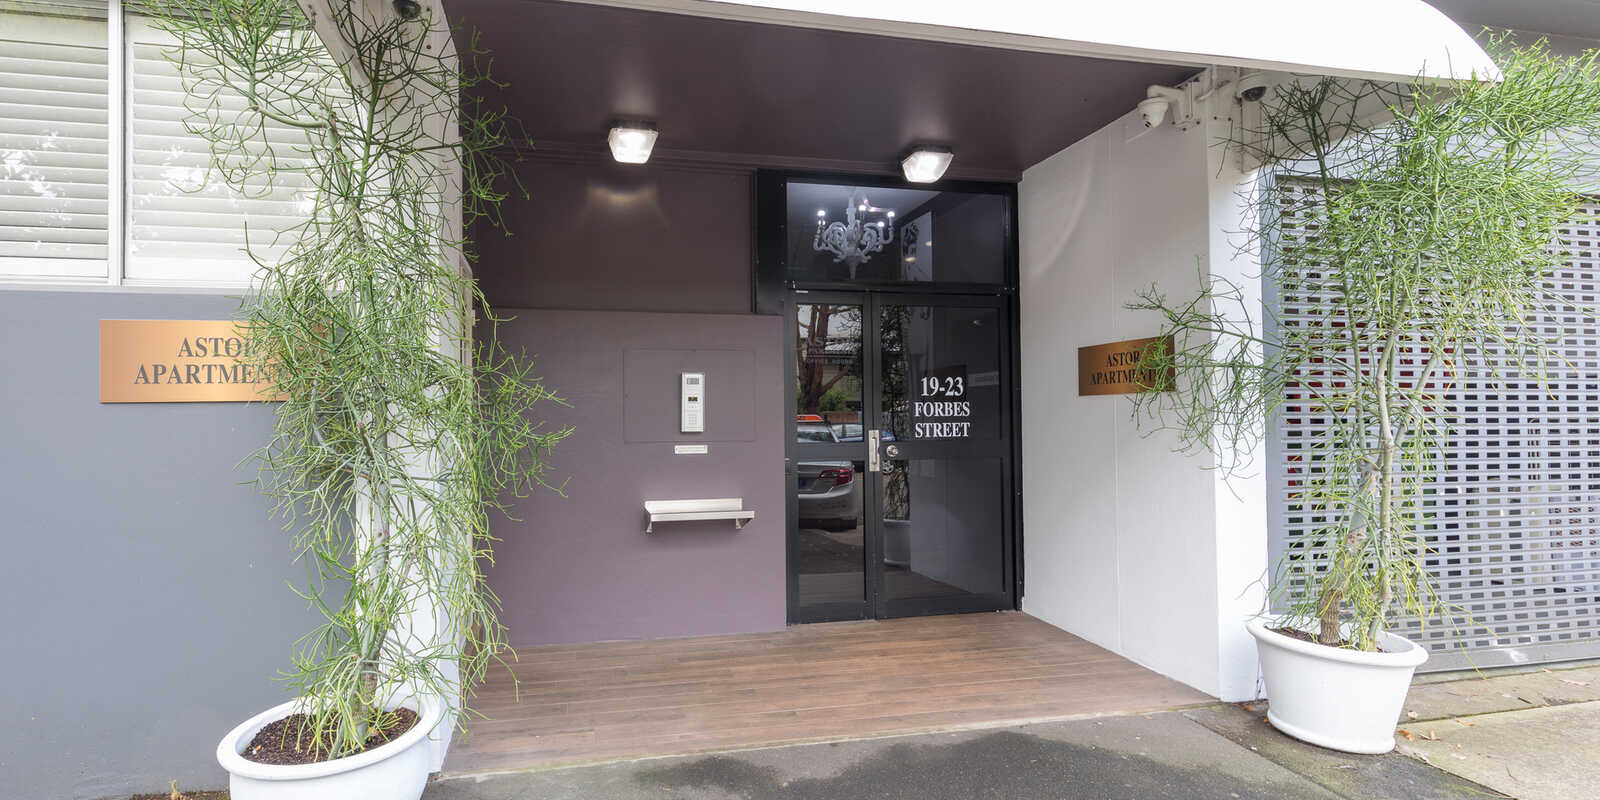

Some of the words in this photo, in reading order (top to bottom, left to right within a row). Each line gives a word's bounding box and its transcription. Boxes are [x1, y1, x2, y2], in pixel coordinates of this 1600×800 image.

[1104, 351, 1141, 368] ASTOR
[133, 363, 284, 385] APARTMEN
[920, 376, 964, 397] 19-23
[914, 401, 971, 417] FORBES
[915, 422, 971, 438] STREET
